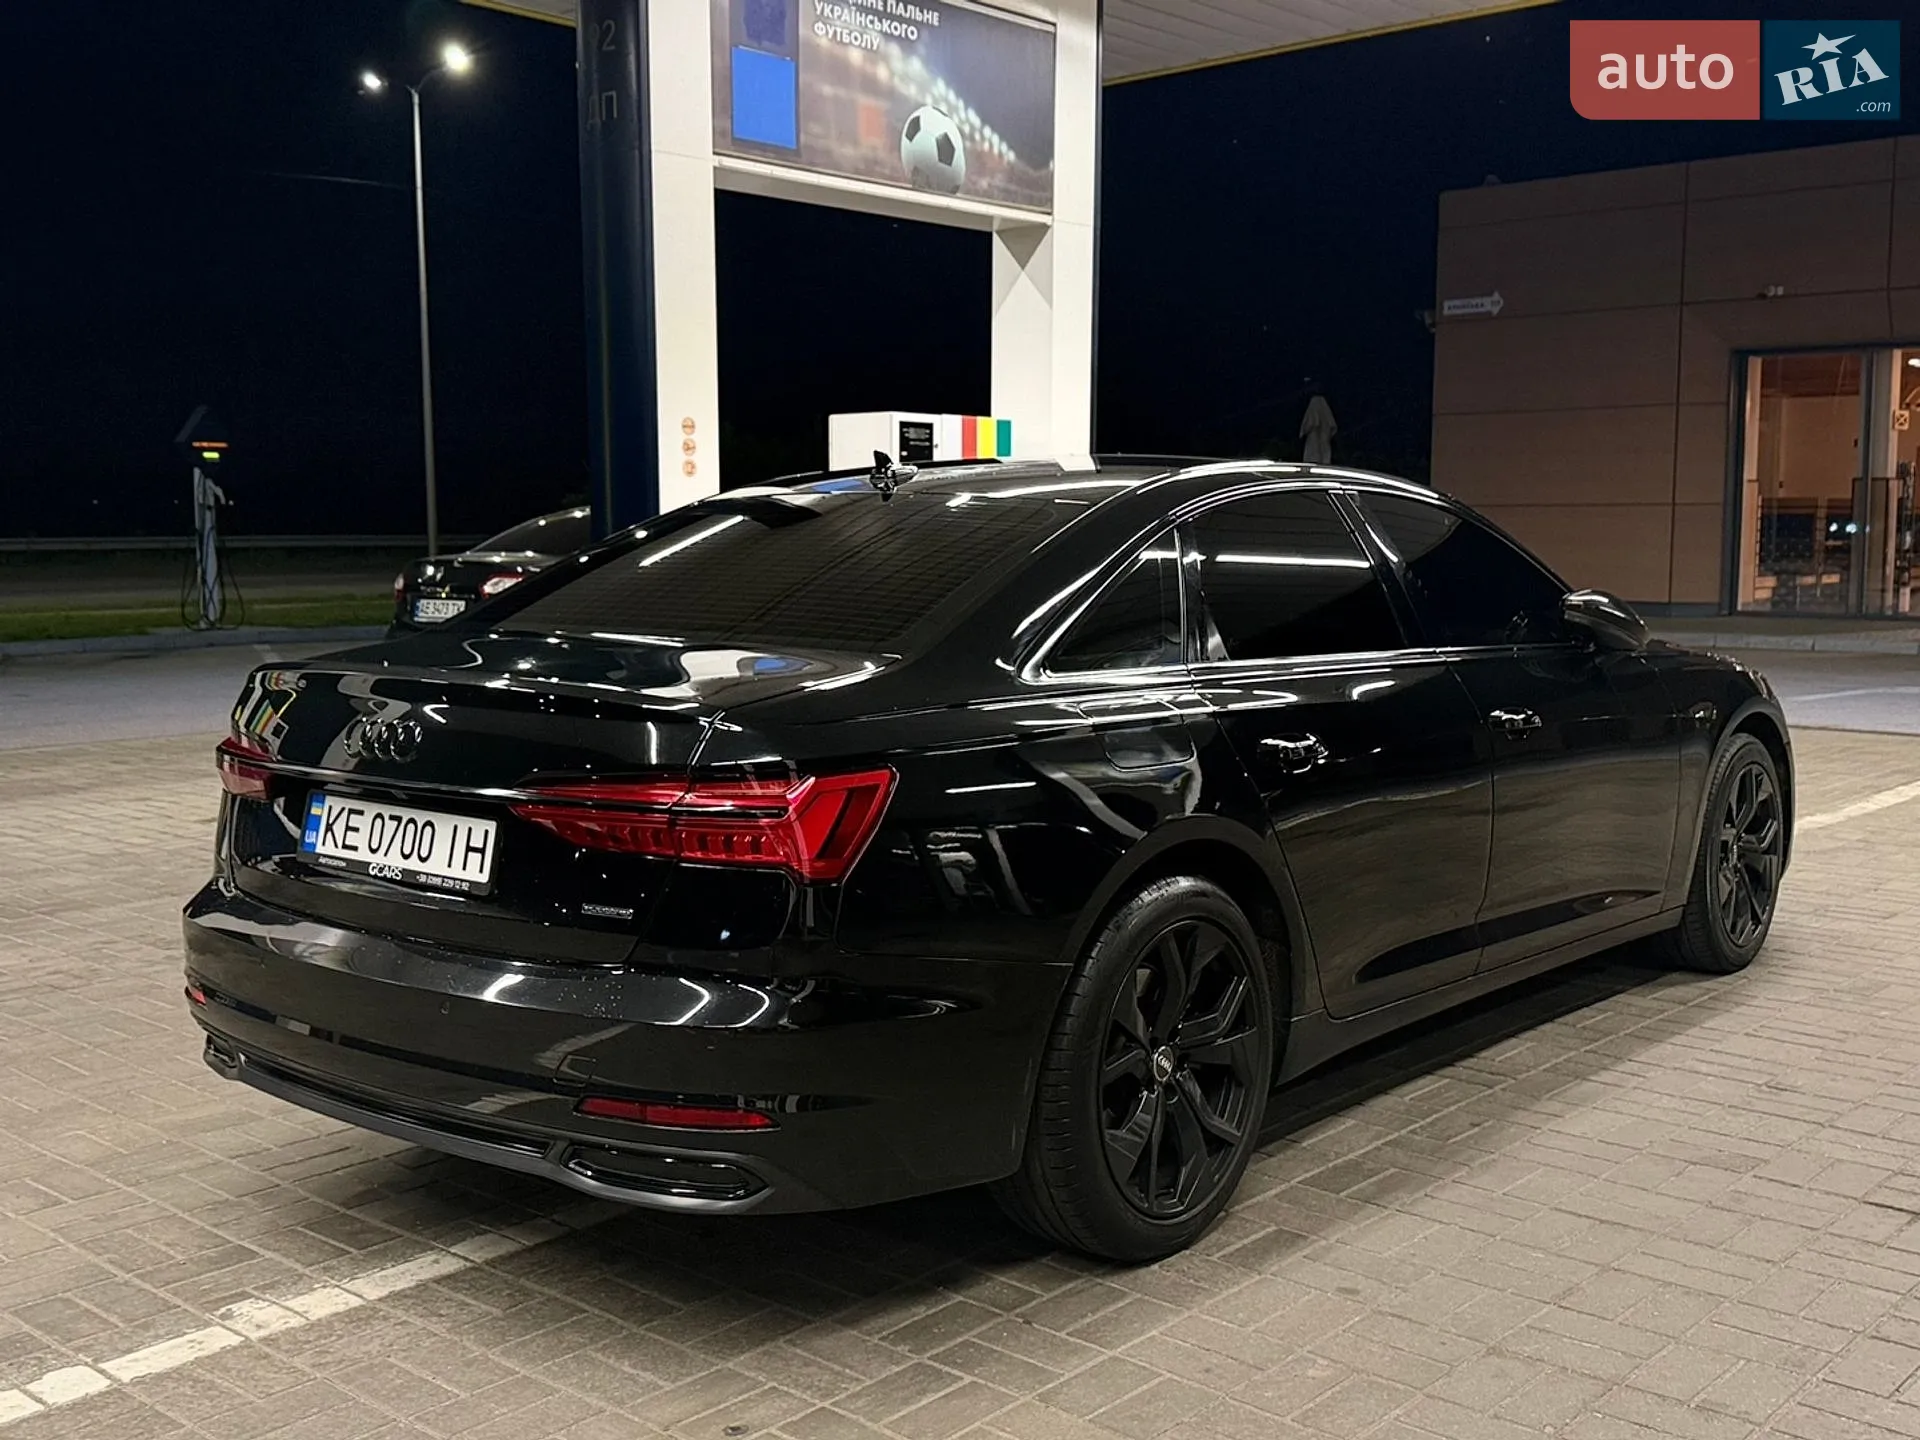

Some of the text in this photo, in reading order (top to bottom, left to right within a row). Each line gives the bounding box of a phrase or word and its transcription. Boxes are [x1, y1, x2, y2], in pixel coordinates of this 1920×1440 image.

[814, 0, 919, 41] УКРАЇНСЬКОГО
[886, 0, 940, 26] ПАЛЬНЕ
[813, 21, 880, 51] ФУТБОЛУ
[304, 829, 317, 844] UA
[322, 805, 490, 874] KE 0700 IH
[368, 863, 403, 881] GCARS
